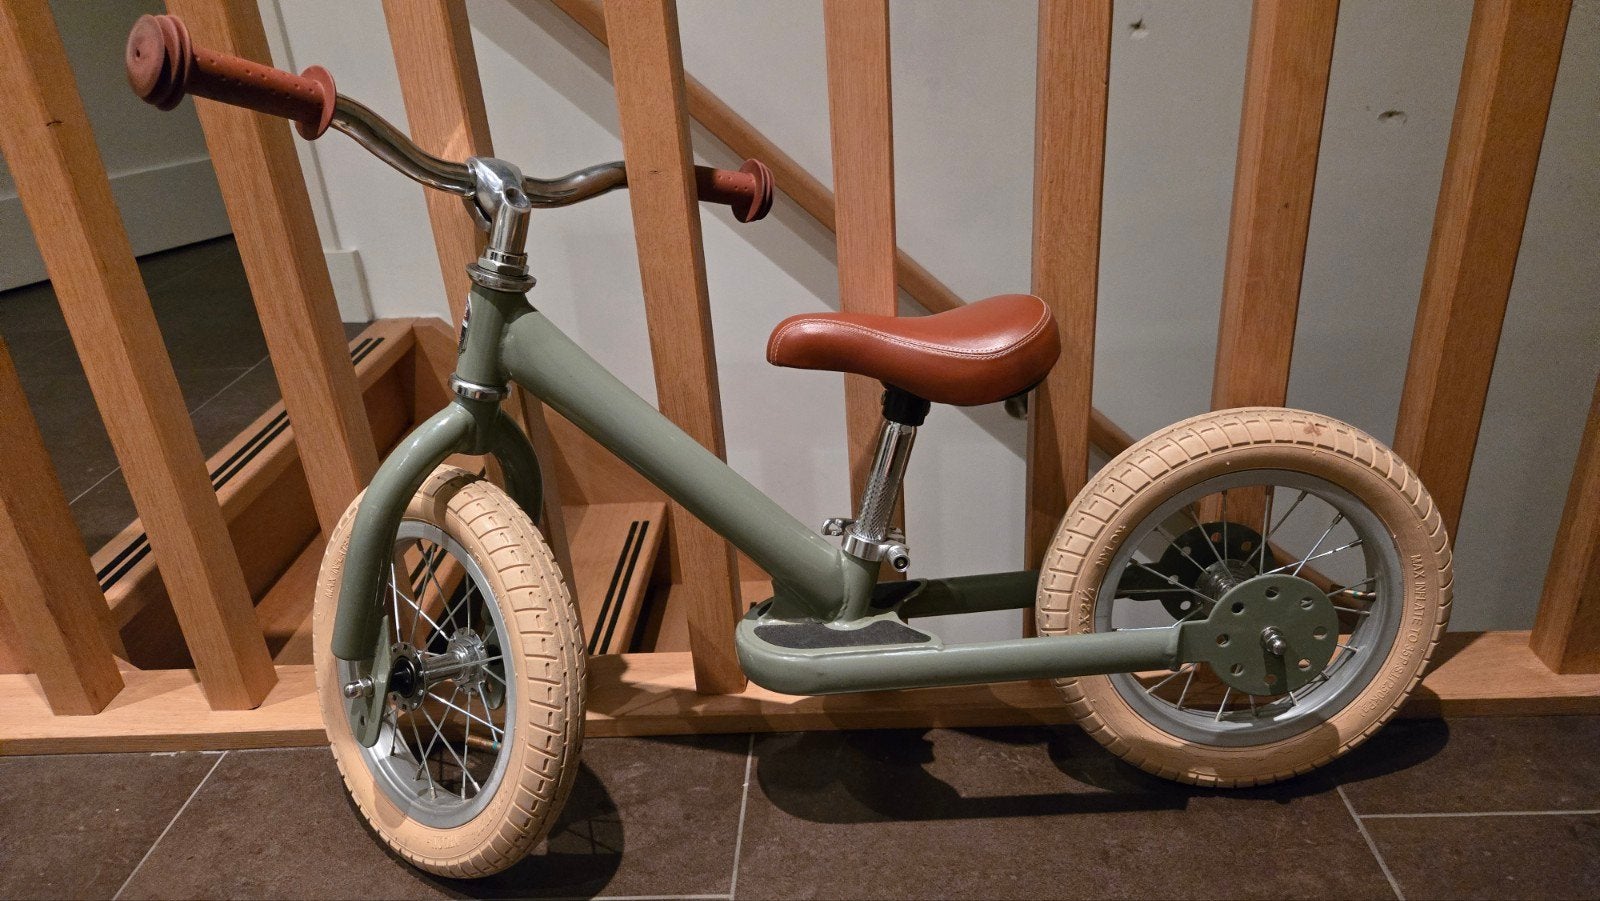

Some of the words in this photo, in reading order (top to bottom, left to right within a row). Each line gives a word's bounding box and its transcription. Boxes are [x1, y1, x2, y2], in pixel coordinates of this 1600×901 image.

[1096, 525, 1126, 566] NYLON
[1410, 554, 1426, 579] MAX
[1411, 581, 1427, 625] INFLATE
[1407, 627, 1421, 643] TO
